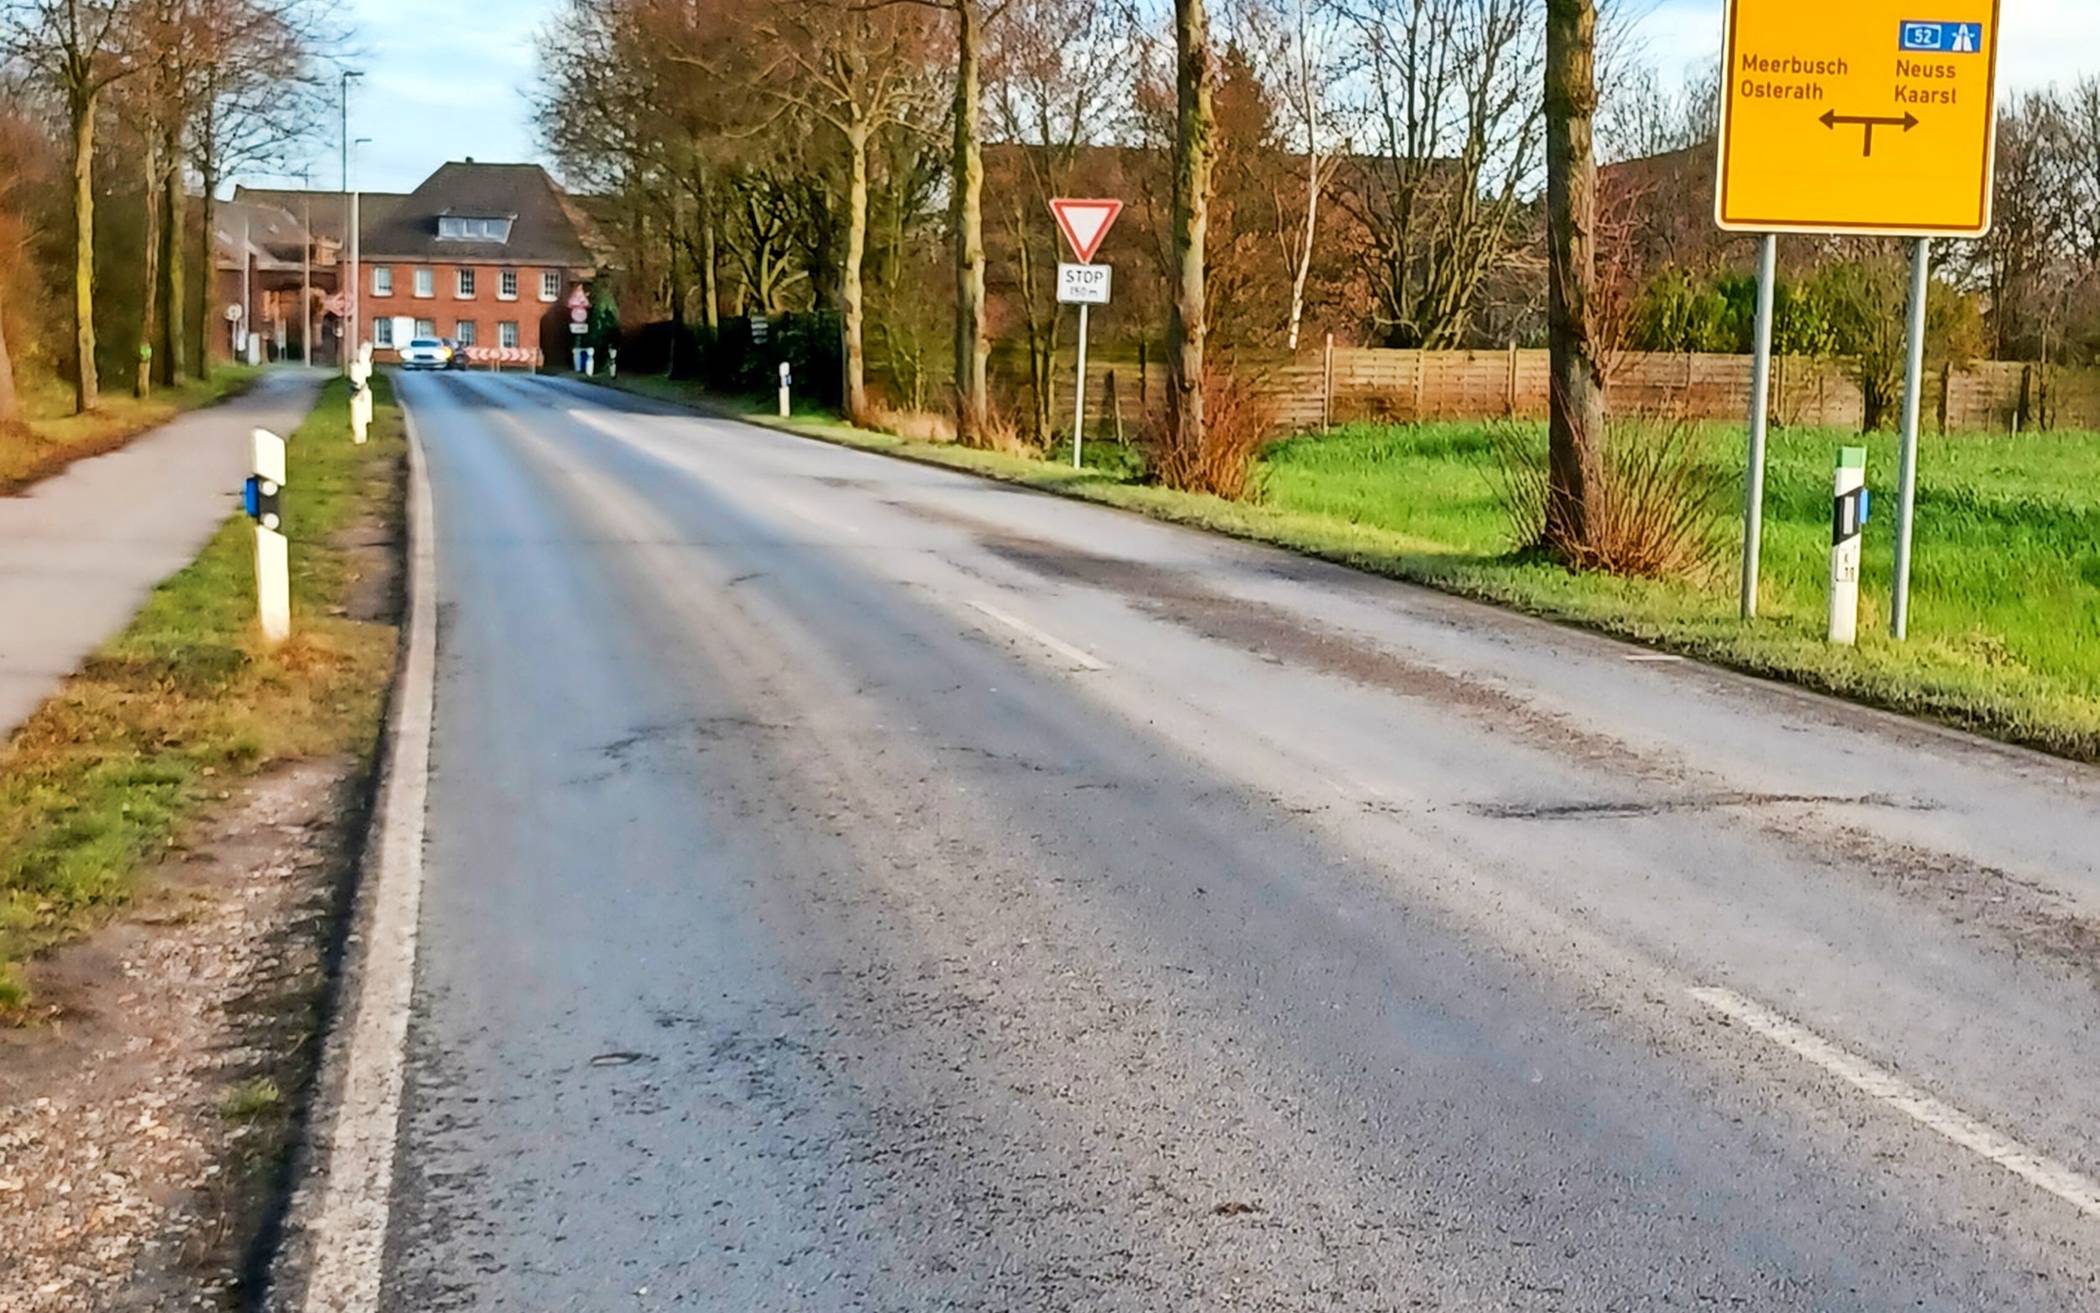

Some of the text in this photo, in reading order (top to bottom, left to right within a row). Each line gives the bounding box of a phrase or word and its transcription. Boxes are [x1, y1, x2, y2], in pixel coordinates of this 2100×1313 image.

[1914, 28, 1932, 44] 52
[1742, 53, 1848, 75] Meerbusch
[1896, 58, 1956, 78] Neuss
[1741, 79, 1823, 100] Osterath
[1894, 84, 1956, 104] Kaarst
[1065, 269, 1104, 284] STOP
